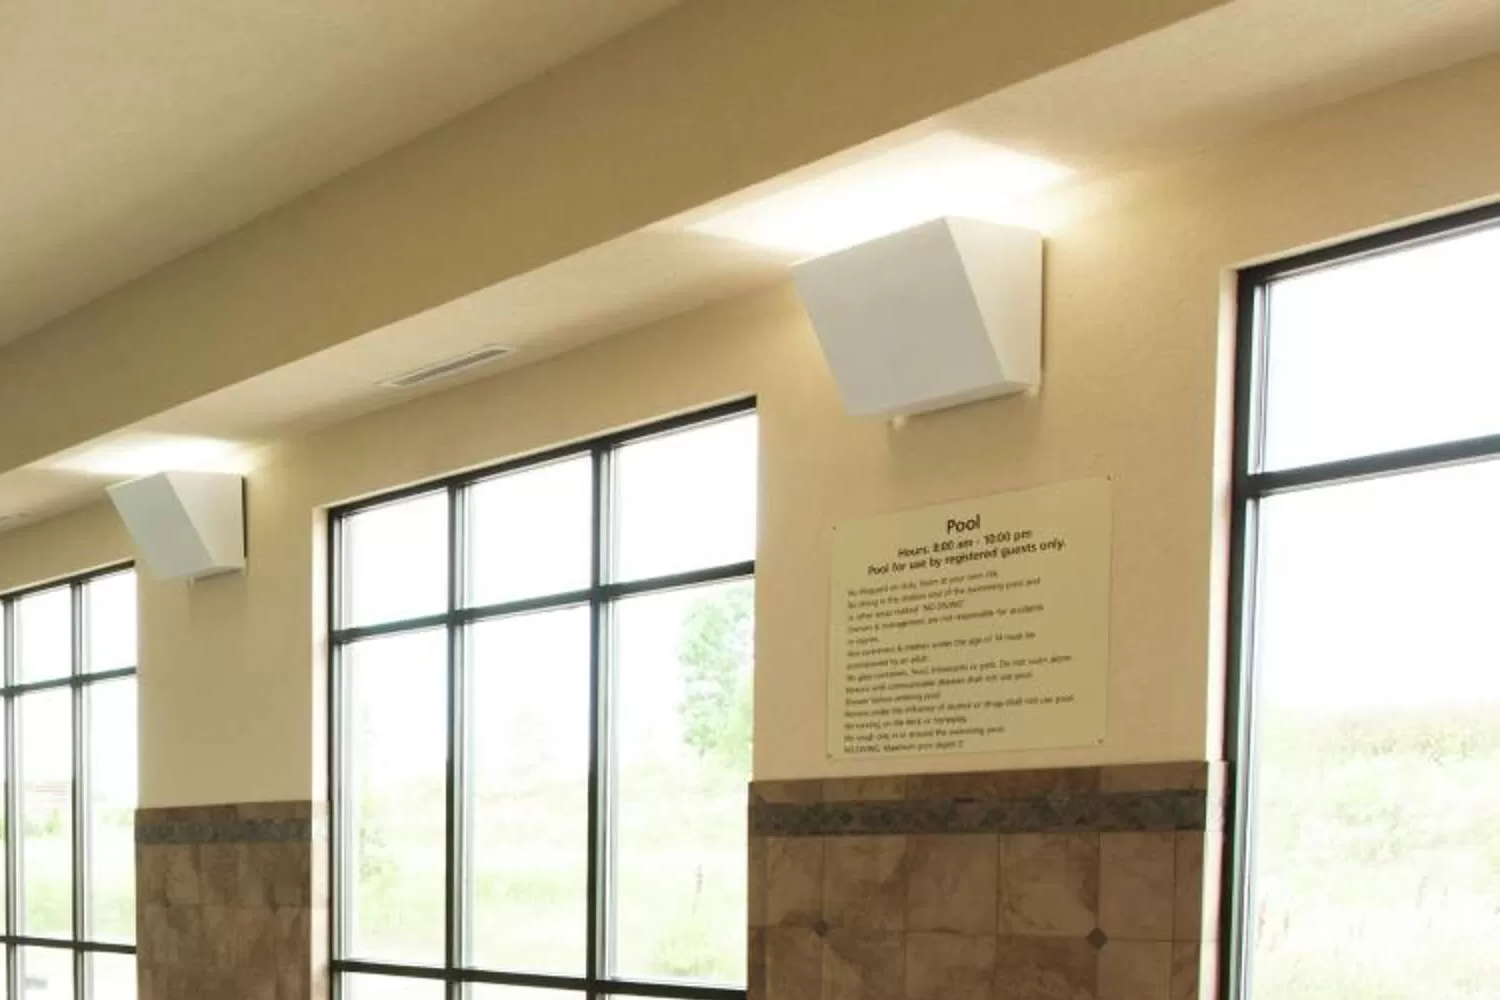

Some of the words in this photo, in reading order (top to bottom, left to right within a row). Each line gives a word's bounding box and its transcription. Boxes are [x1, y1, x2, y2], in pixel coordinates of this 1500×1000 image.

[946, 513, 981, 534] Pool
[1013, 529, 1033, 542] pm
[867, 563, 889, 576] Pool
[891, 561, 906, 573] for
[909, 560, 926, 570] use
[929, 557, 941, 569] by
[945, 547, 998, 564] registered
[1001, 542, 1037, 559] guests
